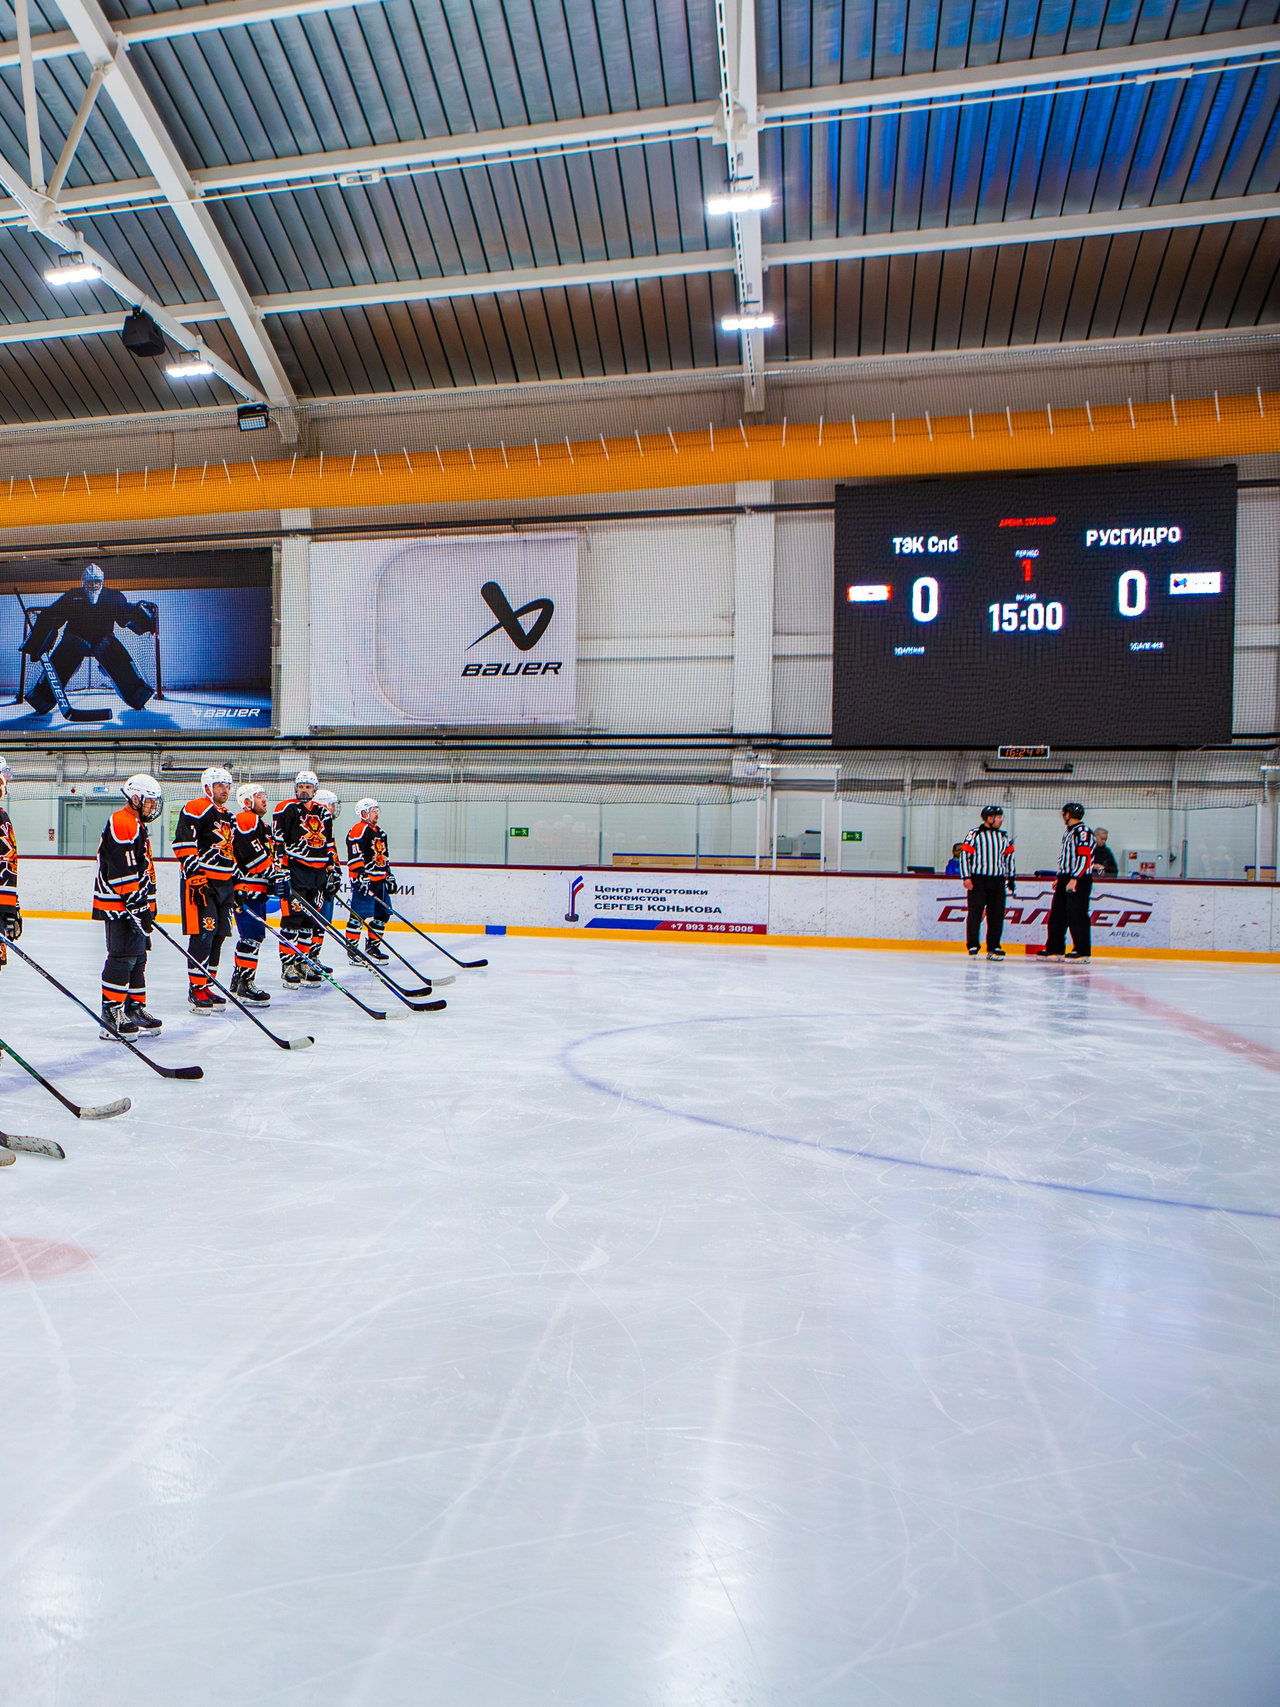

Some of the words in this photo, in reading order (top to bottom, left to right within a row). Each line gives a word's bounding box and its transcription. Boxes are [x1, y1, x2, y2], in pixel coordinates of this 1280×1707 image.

[893, 536, 924, 554] ТЭК
[928, 535, 959, 553] Спб
[1086, 526, 1181, 547] РУСГИДРО
[1021, 559, 1032, 582] 1
[912, 577, 939, 622] 0
[1118, 569, 1147, 617] 0
[989, 602, 1063, 633] 15:00
[461, 662, 562, 677] BAUER
[42, 662, 69, 708] BAUER
[203, 708, 260, 718] BAUER
[1005, 748, 1033, 758] 16:24
[594, 885, 633, 894] Центр
[594, 894, 667, 902] хоккеистов
[594, 903, 644, 912] СЕРГЕЯ
[647, 904, 723, 914] КОНЬКОВА
[937, 905, 1153, 927] САЛЕР
[685, 923, 704, 931] 993
[707, 924, 726, 932] 346
[728, 925, 754, 933] 3005
[1109, 930, 1140, 938] АРЕНА
